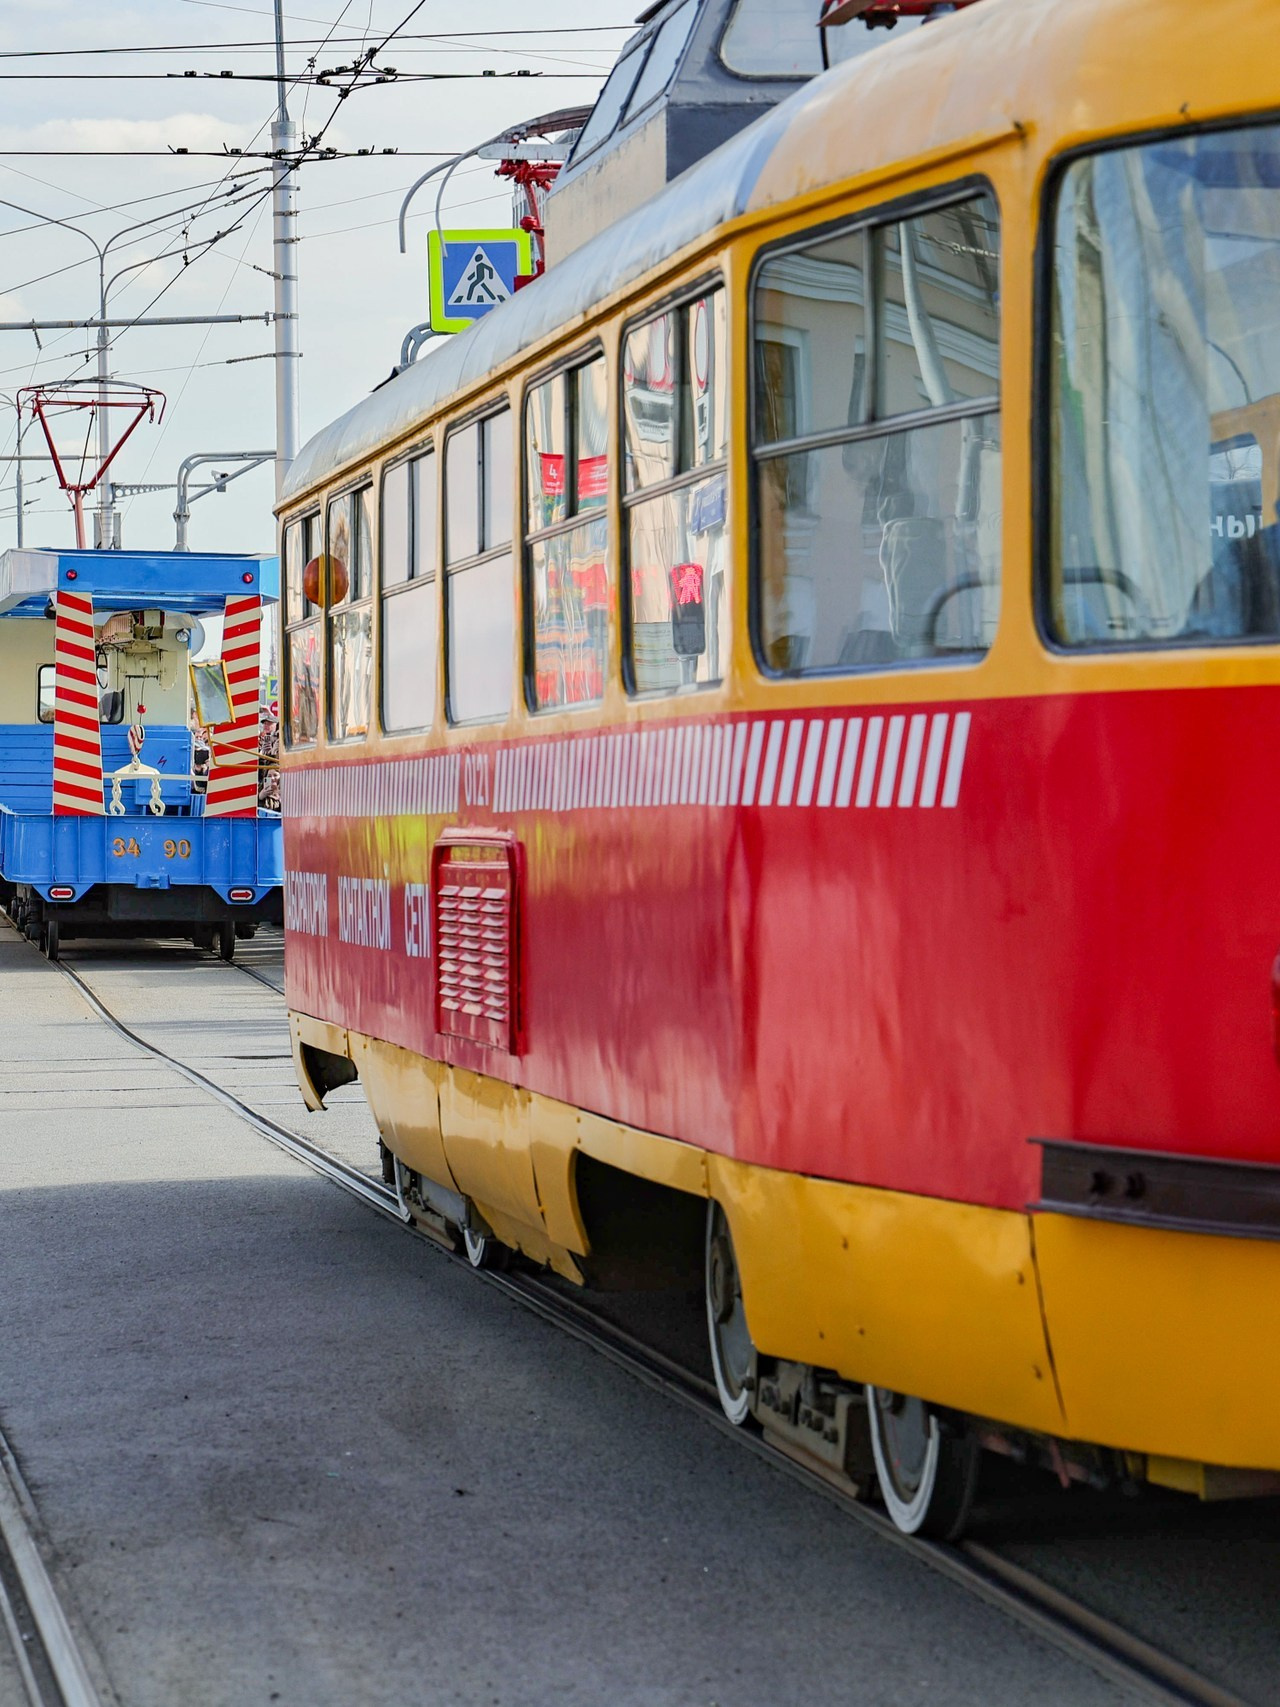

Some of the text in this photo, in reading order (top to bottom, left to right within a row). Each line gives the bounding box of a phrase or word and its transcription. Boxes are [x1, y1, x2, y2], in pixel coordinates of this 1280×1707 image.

[464, 753, 489, 806] 0121
[113, 837, 191, 860] 34 90
[338, 864, 391, 950] КОНТАКТНОЙ
[405, 882, 430, 958] СЕТИ
